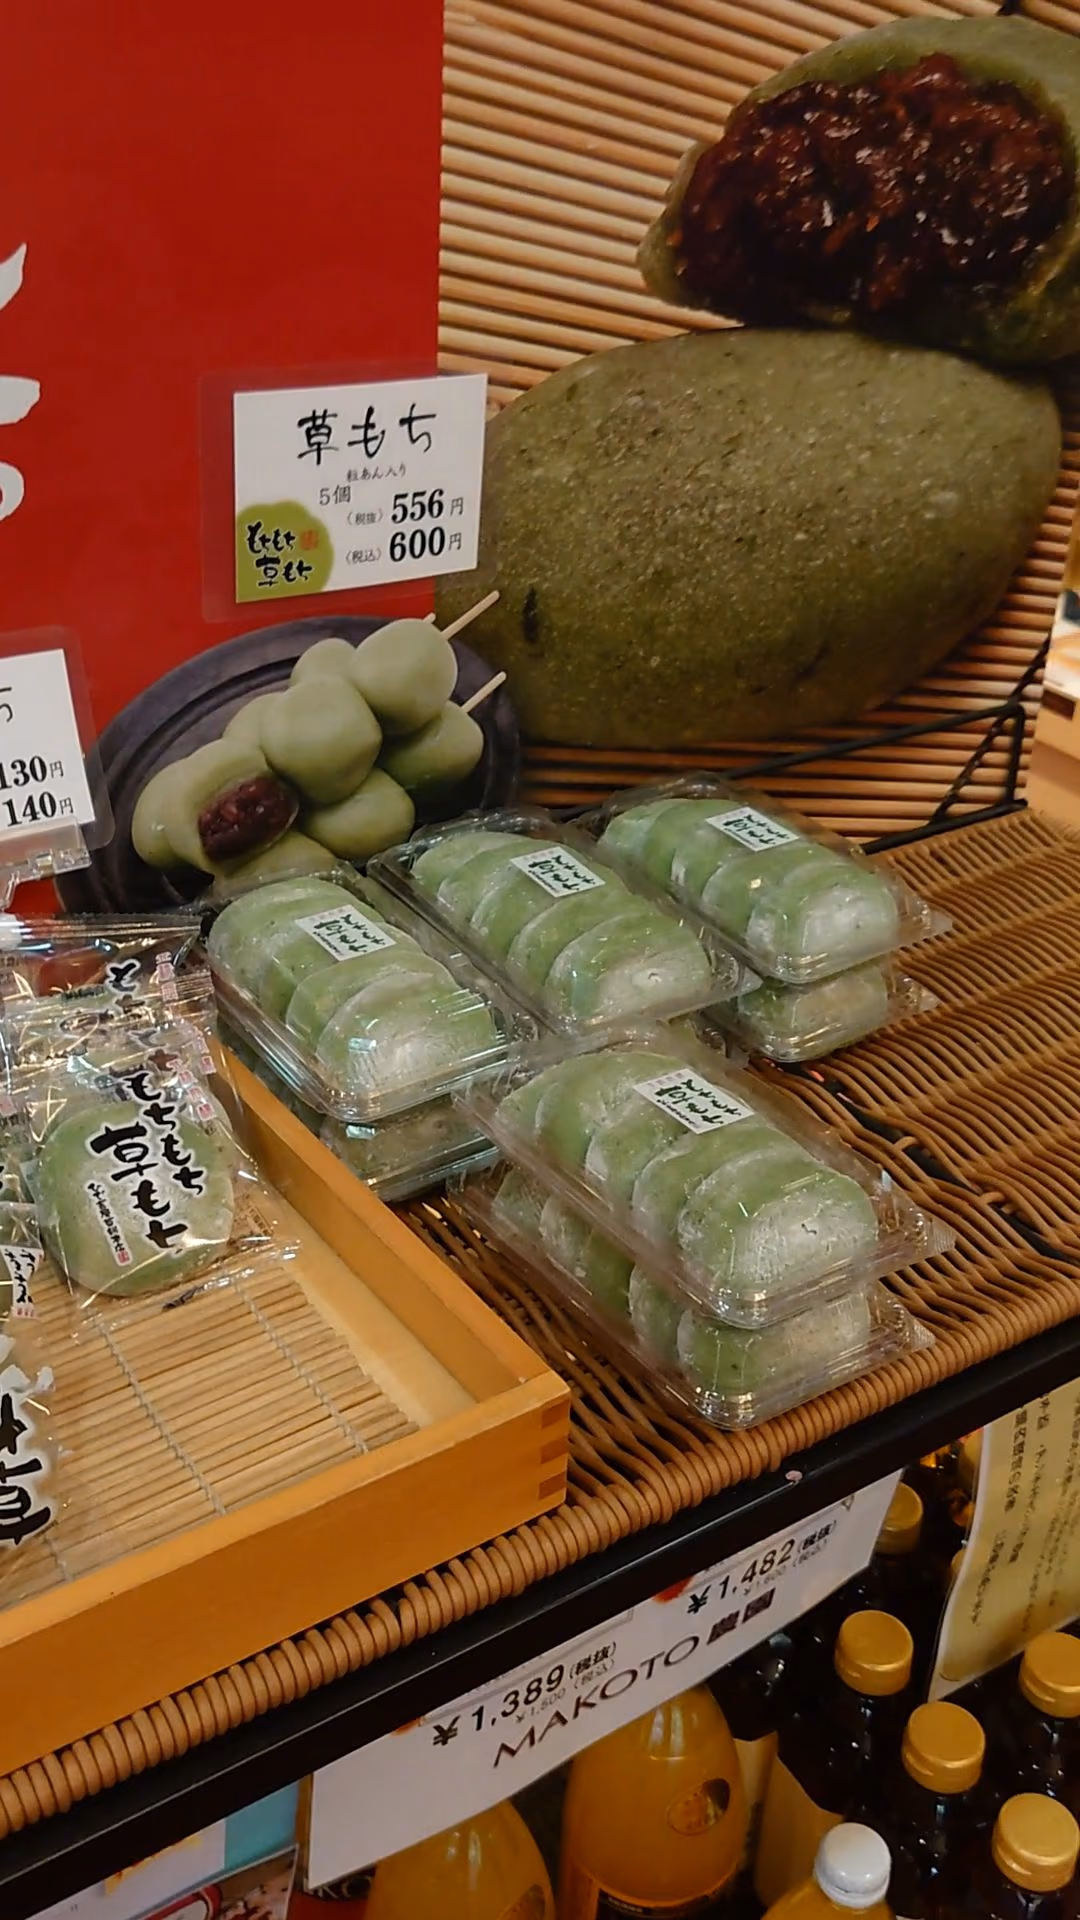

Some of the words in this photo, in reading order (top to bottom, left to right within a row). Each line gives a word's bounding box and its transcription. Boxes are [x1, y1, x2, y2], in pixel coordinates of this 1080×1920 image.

[297, 403, 437, 465] 草もち
[319, 485, 351, 505] 5個
[255, 554, 313, 588] 草もち
[123, 1073, 203, 1195] もちもち
[90, 1121, 188, 1256] 草もち
[687, 1539, 796, 1614] ¥1,482
[433, 1664, 565, 1746] ¥1,389
